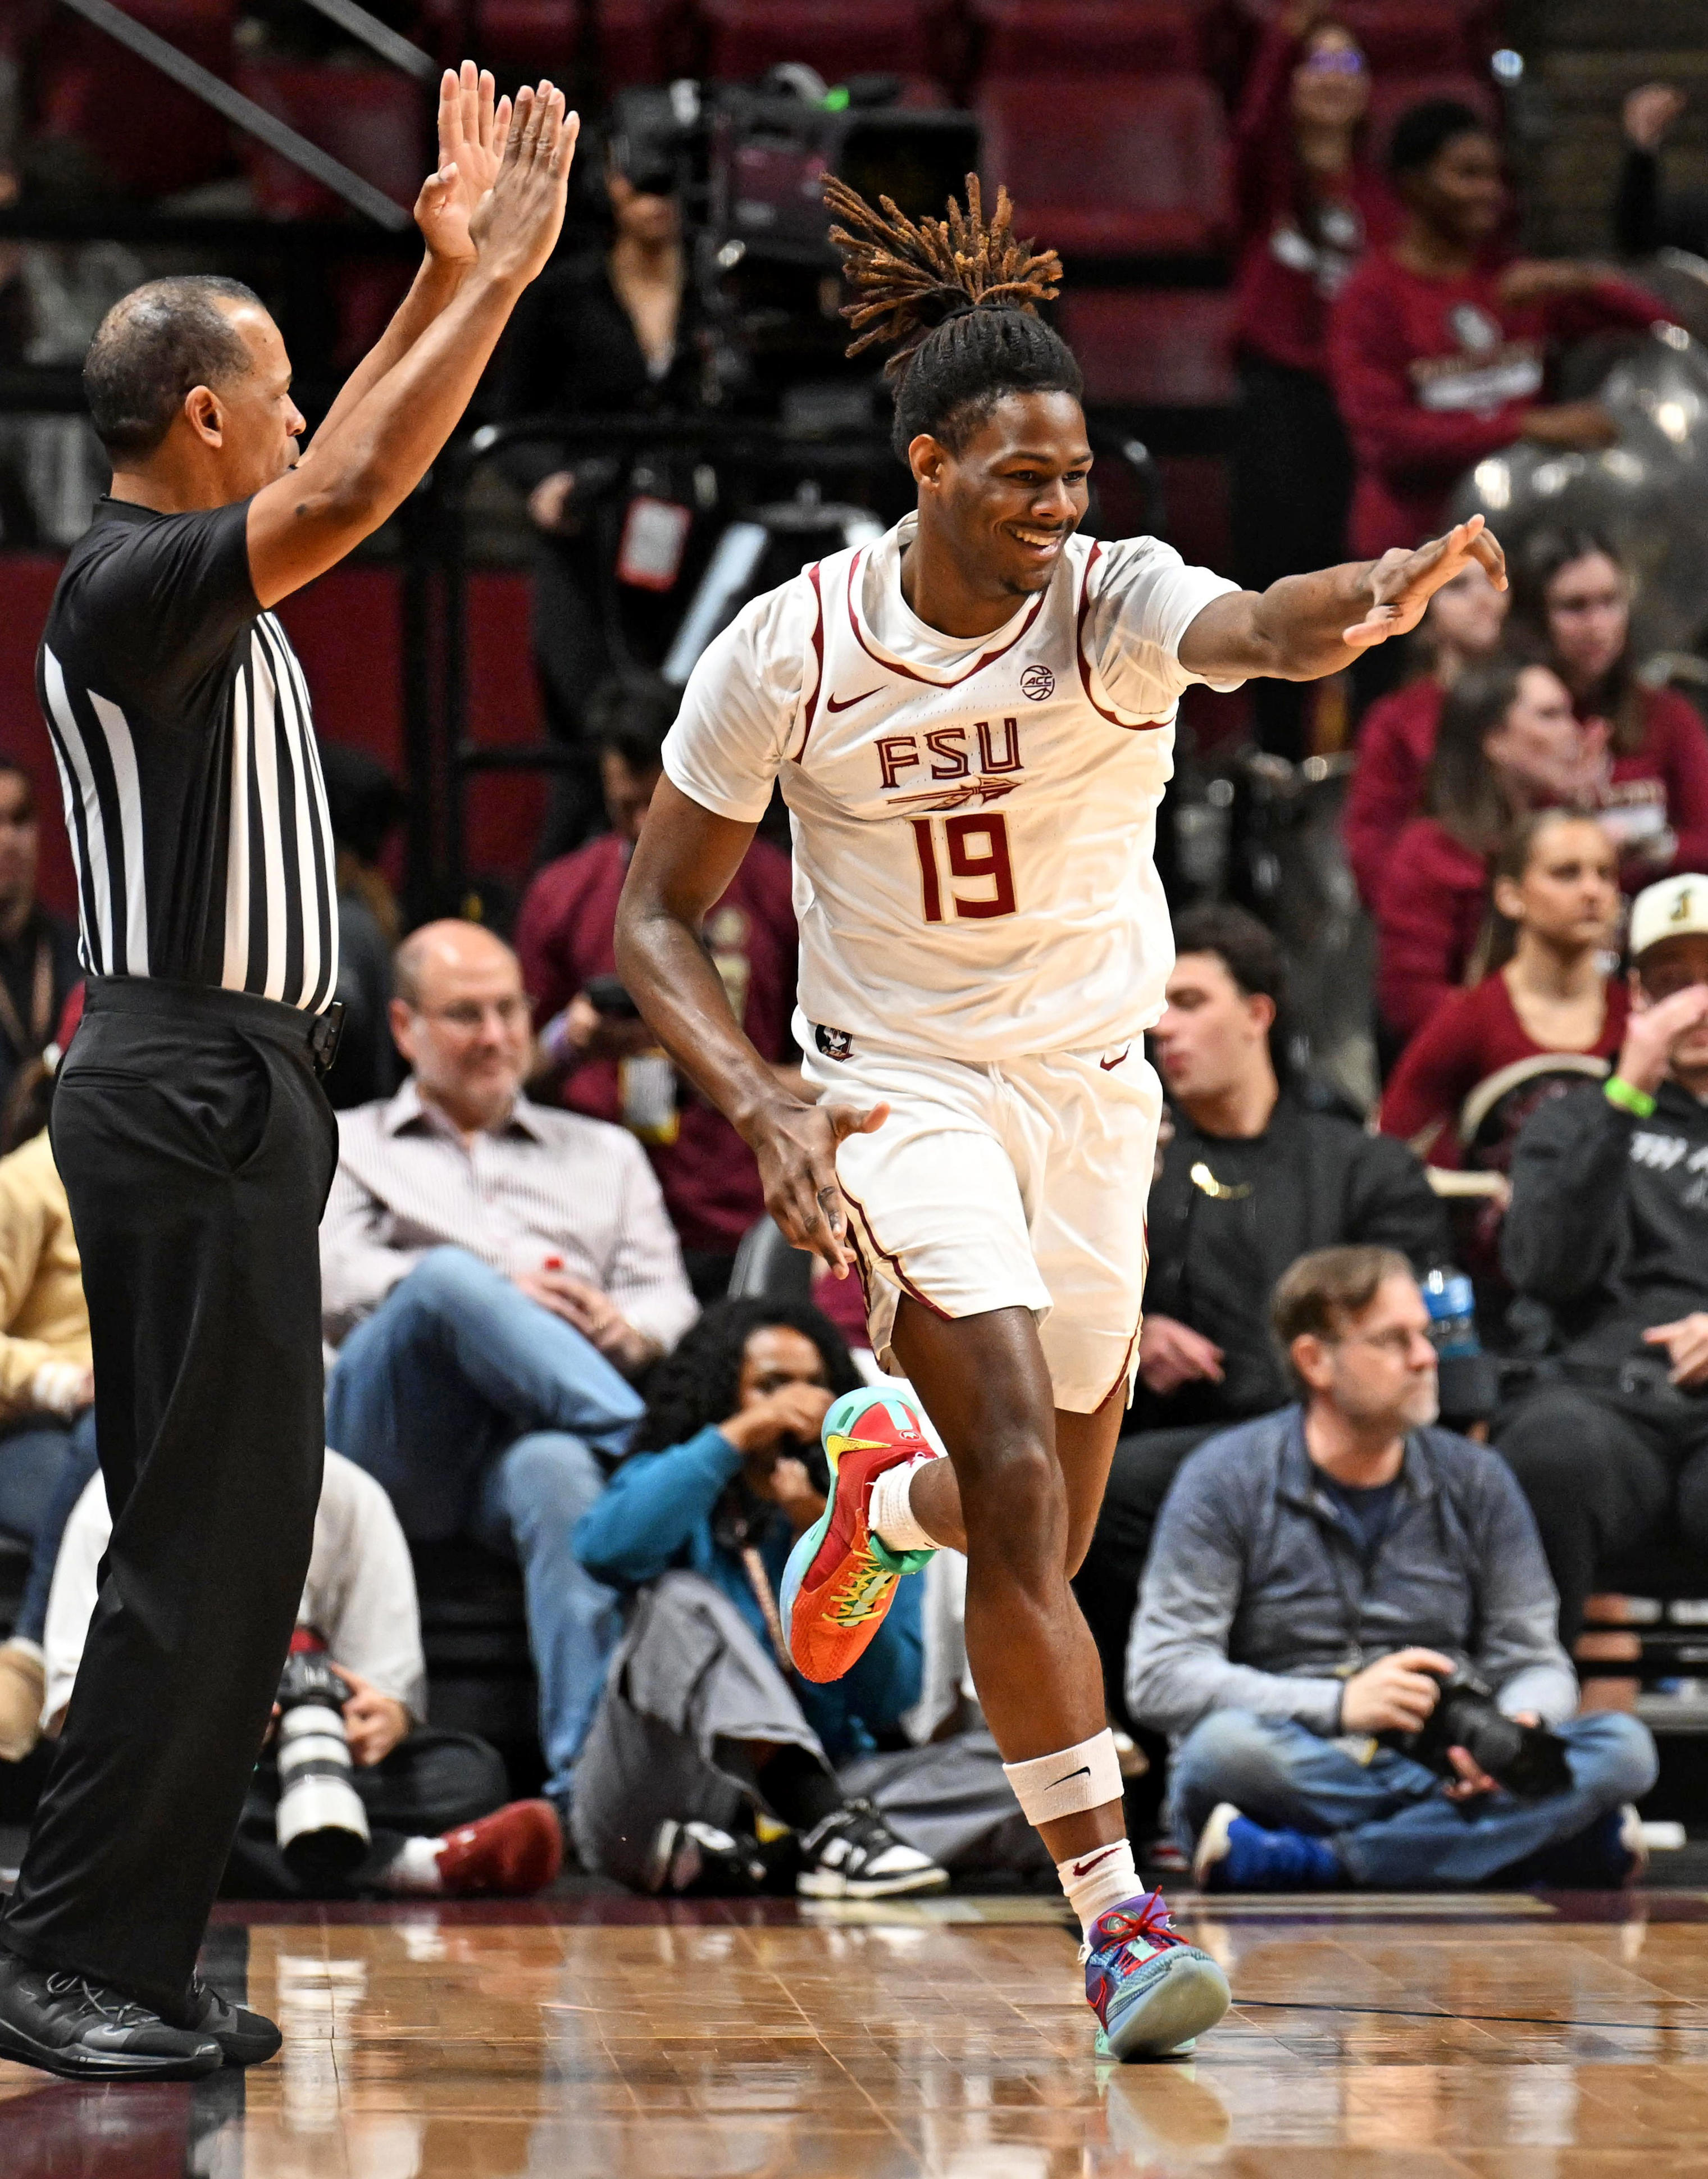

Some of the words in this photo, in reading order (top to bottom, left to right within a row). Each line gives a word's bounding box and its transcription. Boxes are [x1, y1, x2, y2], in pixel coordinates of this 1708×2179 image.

[1024, 676, 1053, 686] ACC
[874, 718, 1024, 788] FSU
[903, 810, 1019, 925] 19
